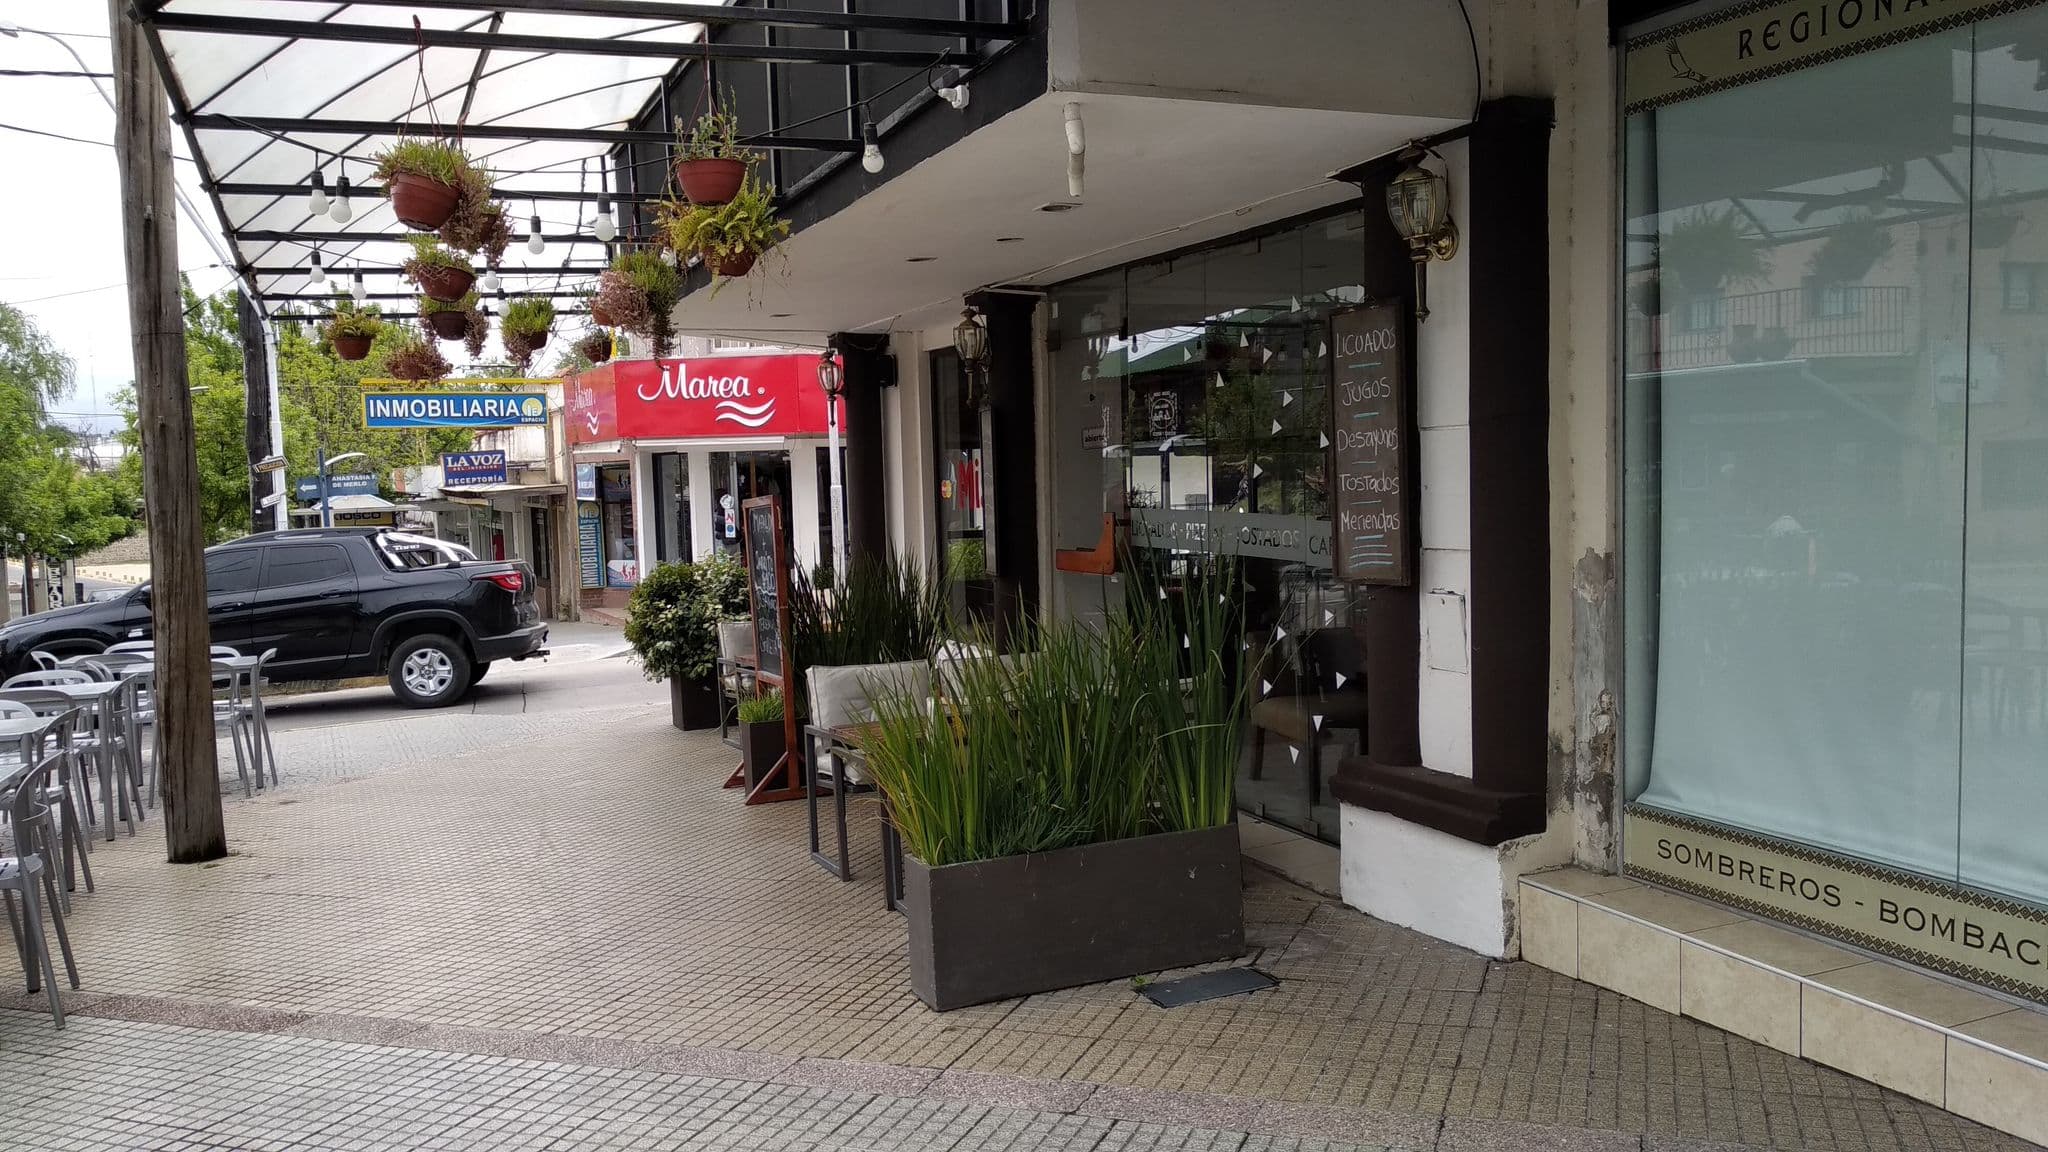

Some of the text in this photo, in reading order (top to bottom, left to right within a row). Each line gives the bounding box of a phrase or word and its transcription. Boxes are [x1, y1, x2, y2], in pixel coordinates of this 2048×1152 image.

[1336, 327, 1396, 358] LICUADOS
[637, 363, 751, 401] Marea
[1341, 376, 1391, 406] JUGOS
[369, 399, 520, 418] INMOBILIARIA
[446, 453, 503, 467] LA VOZ
[1340, 507, 1400, 533] Meriendas
[1656, 838, 1842, 908] SOMBREROS
[1879, 898, 2048, 970] BOMBAC
